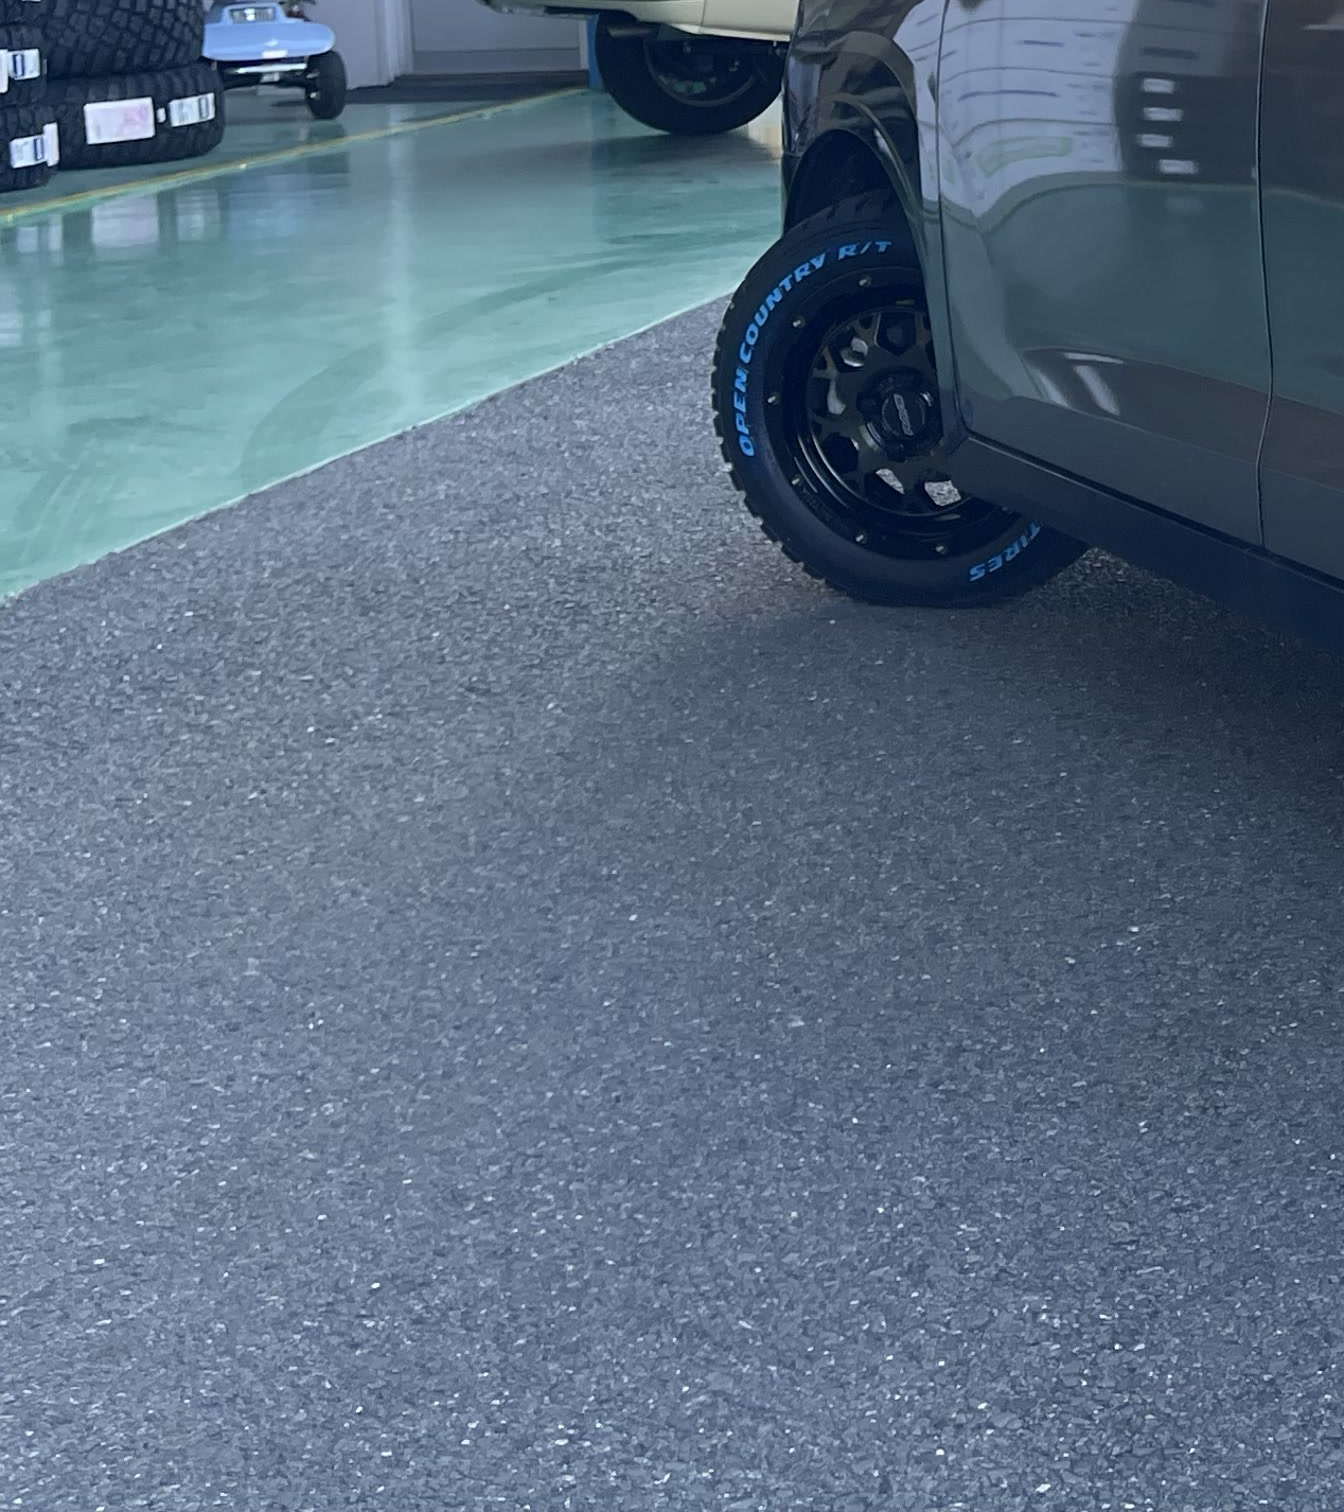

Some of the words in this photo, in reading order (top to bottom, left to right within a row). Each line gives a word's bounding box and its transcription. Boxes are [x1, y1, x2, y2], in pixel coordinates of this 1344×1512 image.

[838, 241, 892, 260] R/T
[740, 253, 827, 363] COUNTRY
[734, 367, 754, 456] OPEN
